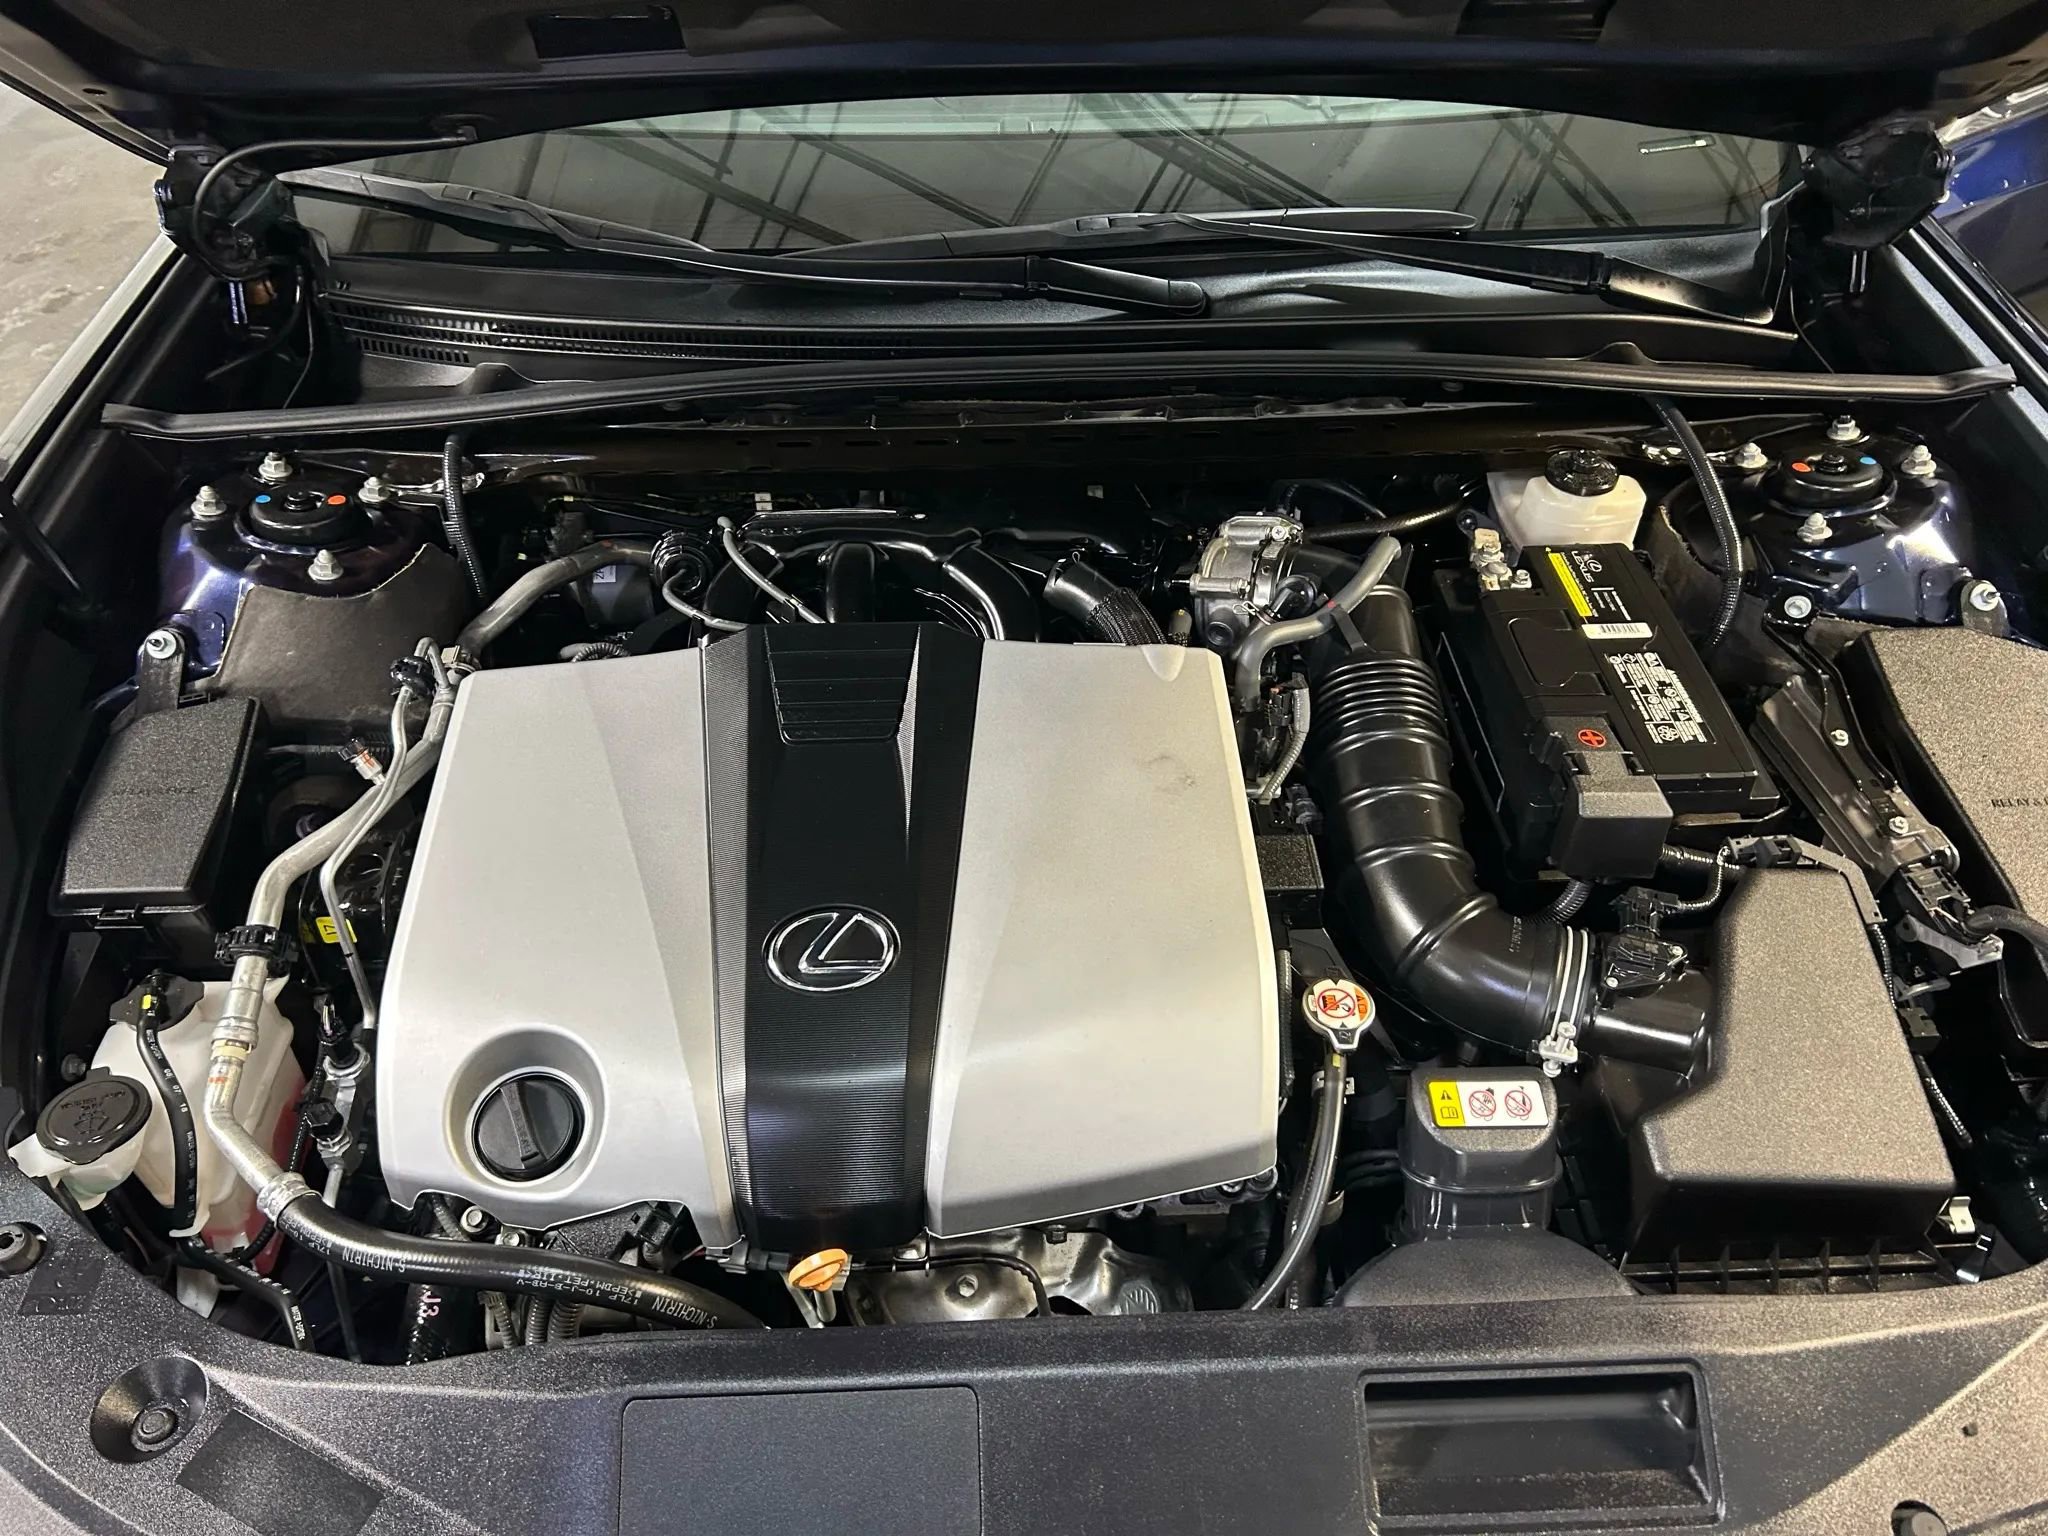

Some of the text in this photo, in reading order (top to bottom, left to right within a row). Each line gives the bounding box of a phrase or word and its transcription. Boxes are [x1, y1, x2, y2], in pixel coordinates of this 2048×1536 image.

[1571, 551, 1595, 582] LEXUS
[1991, 798, 2029, 808] RELAY
[608, 1293, 639, 1306] 17LP
